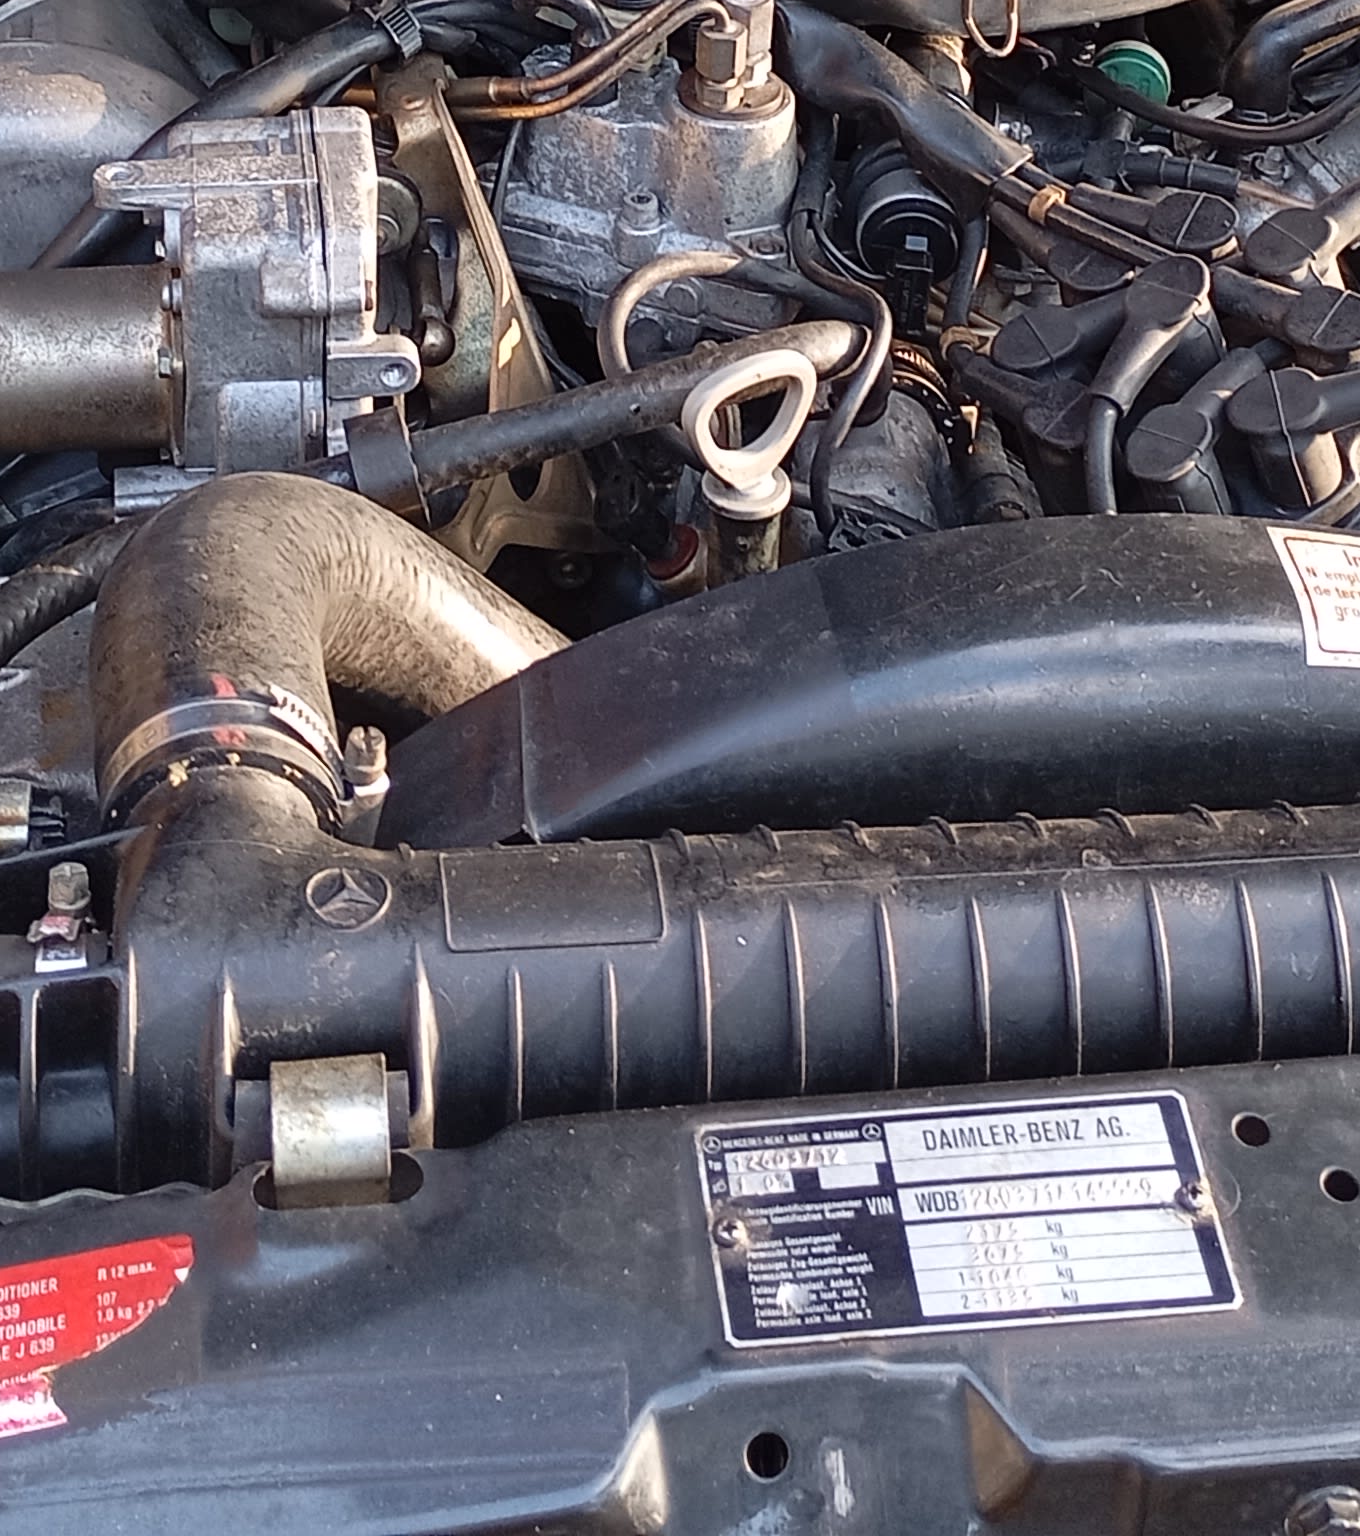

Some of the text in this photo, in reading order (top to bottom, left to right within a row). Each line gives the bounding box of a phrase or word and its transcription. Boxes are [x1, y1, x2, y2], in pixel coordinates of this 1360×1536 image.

[922, 1115, 1131, 1152] DAIMLER-BENZ AG.
[865, 1196, 894, 1215] VIN
[1045, 1219, 1063, 1237] kg
[791, 1247, 809, 1255] total
[811, 1244, 837, 1254] weight
[1051, 1241, 1069, 1259] kg
[748, 1262, 874, 1282] Permissible combination weight
[829, 1278, 854, 1288] Achse
[1056, 1264, 1074, 1282] kg
[96, 1291, 117, 1307] 107
[834, 1300, 858, 1310] Achse
[1061, 1286, 1079, 1304] kg
[117, 1305, 132, 1320] kg
[756, 1317, 802, 1328] Permissible
[804, 1314, 822, 1325] axle
[15, 1343, 24, 1359] J
[29, 1337, 55, 1356] 639
